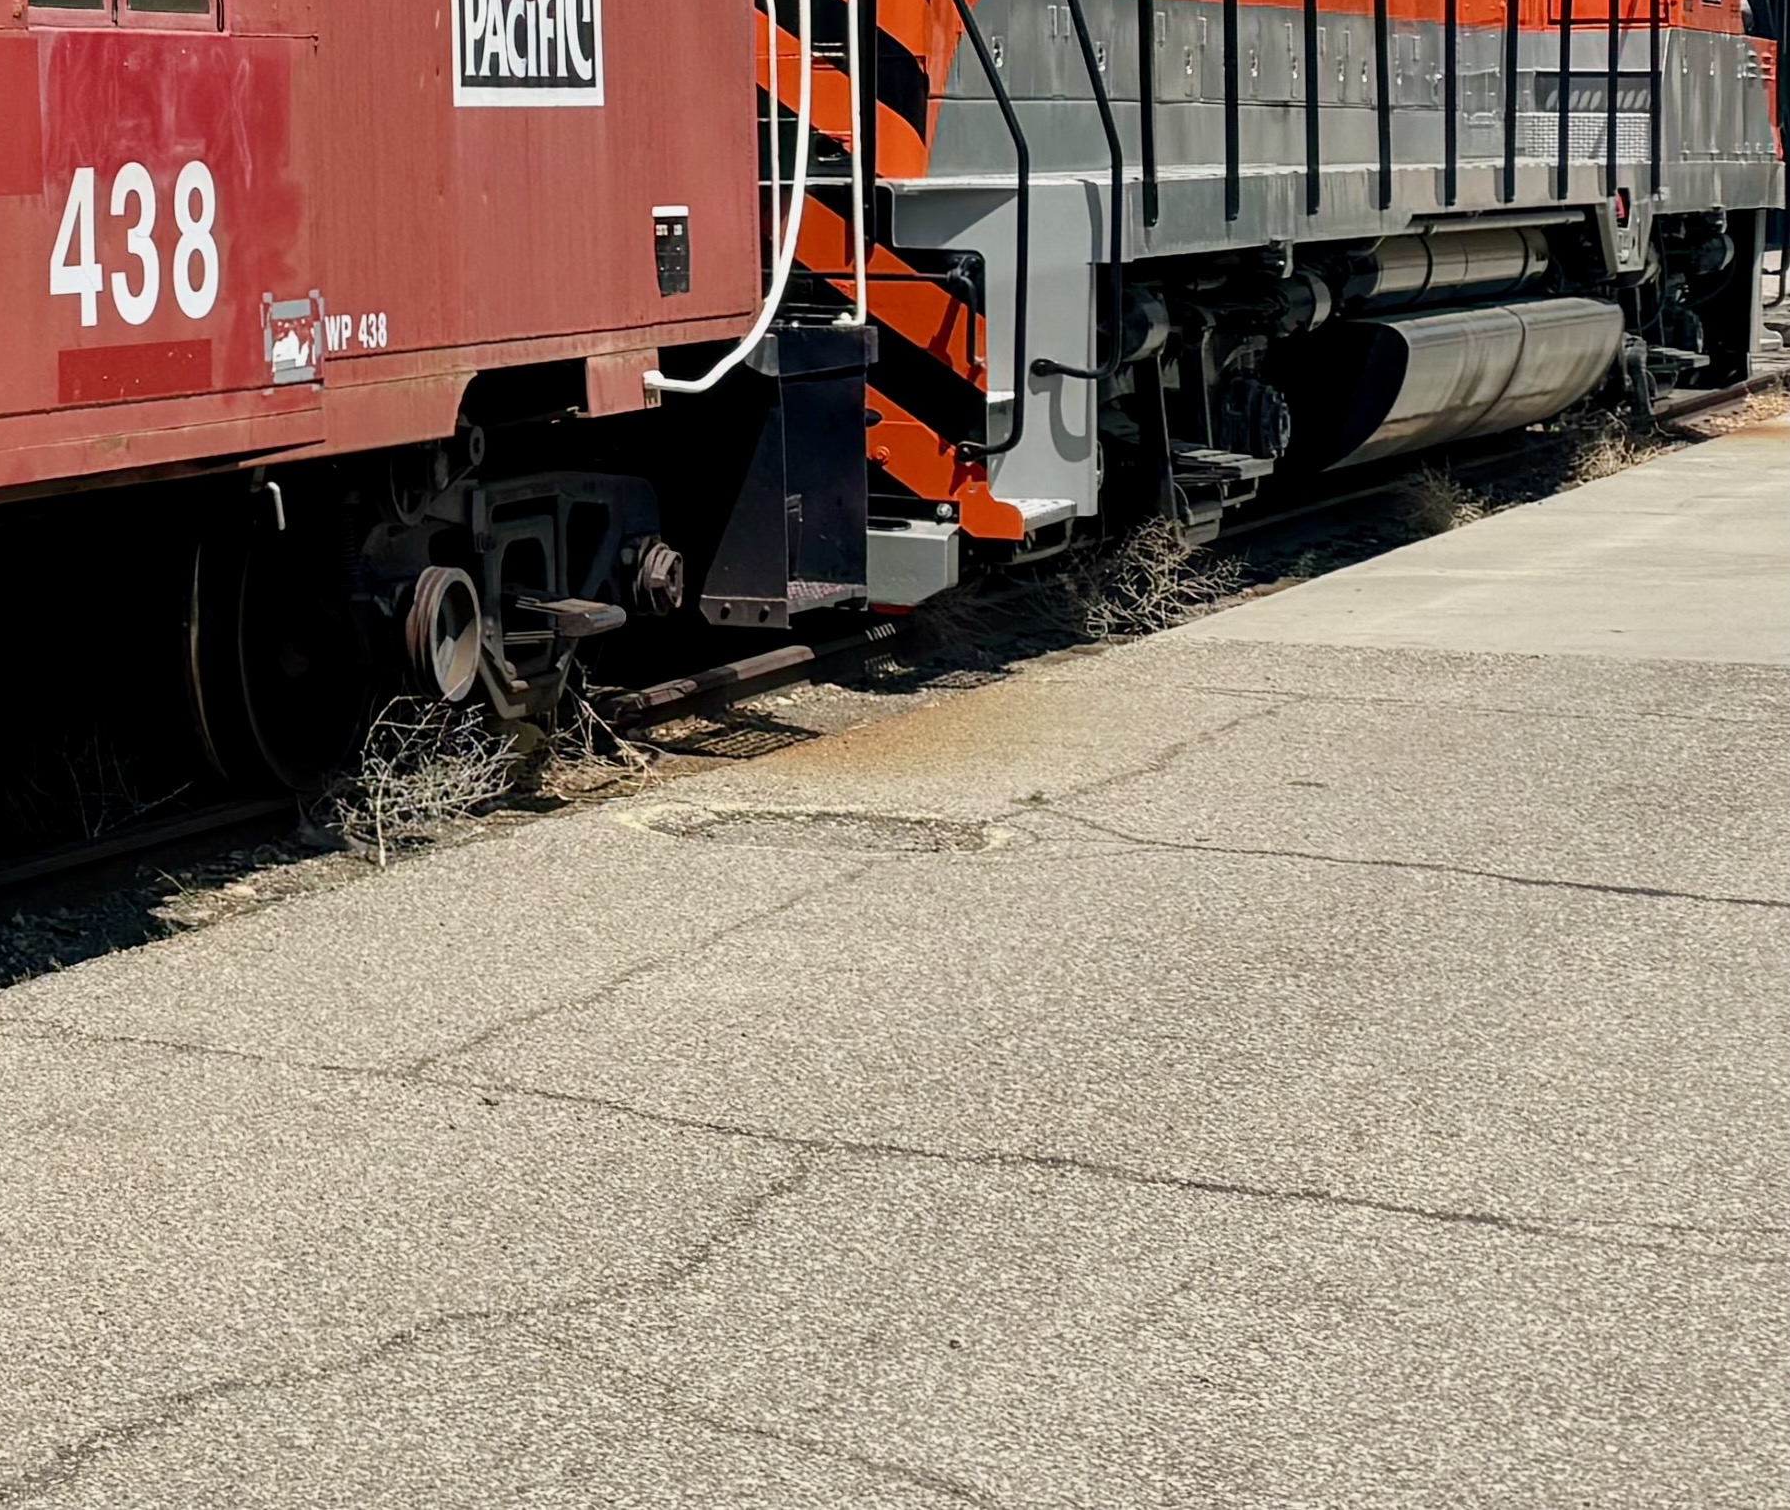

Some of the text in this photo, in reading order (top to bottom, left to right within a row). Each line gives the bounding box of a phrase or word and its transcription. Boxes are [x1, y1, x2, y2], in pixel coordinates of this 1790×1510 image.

[50, 161, 219, 327] 438
[324, 312, 388, 352] WP 438
